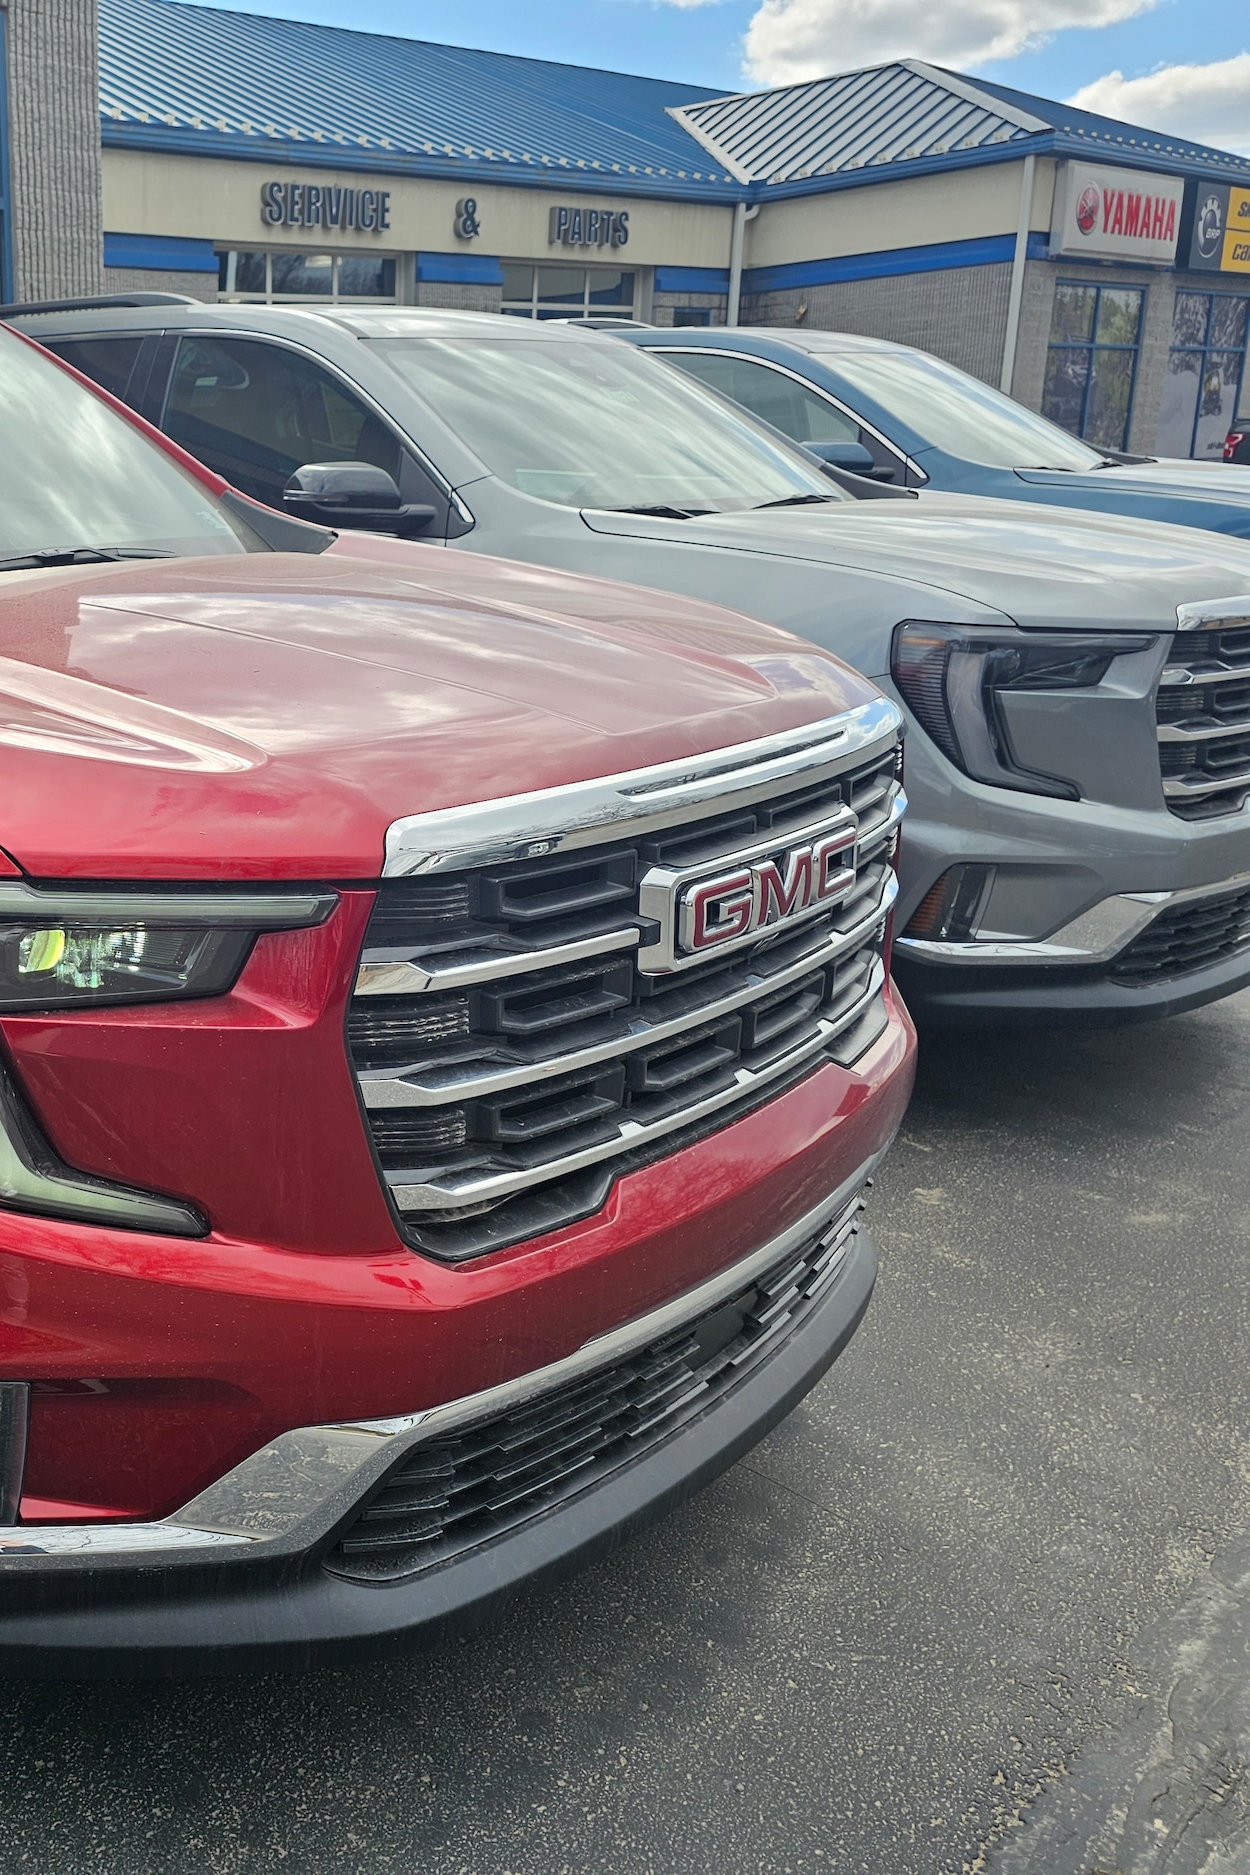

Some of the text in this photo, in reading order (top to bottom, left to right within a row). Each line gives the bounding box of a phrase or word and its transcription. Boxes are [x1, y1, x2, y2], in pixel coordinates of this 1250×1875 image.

[262, 181, 630, 247] SERVICE & PARTS
[1102, 187, 1177, 243] YAMAHA
[1205, 227, 1221, 240] BRP
[679, 825, 857, 954] GMC
